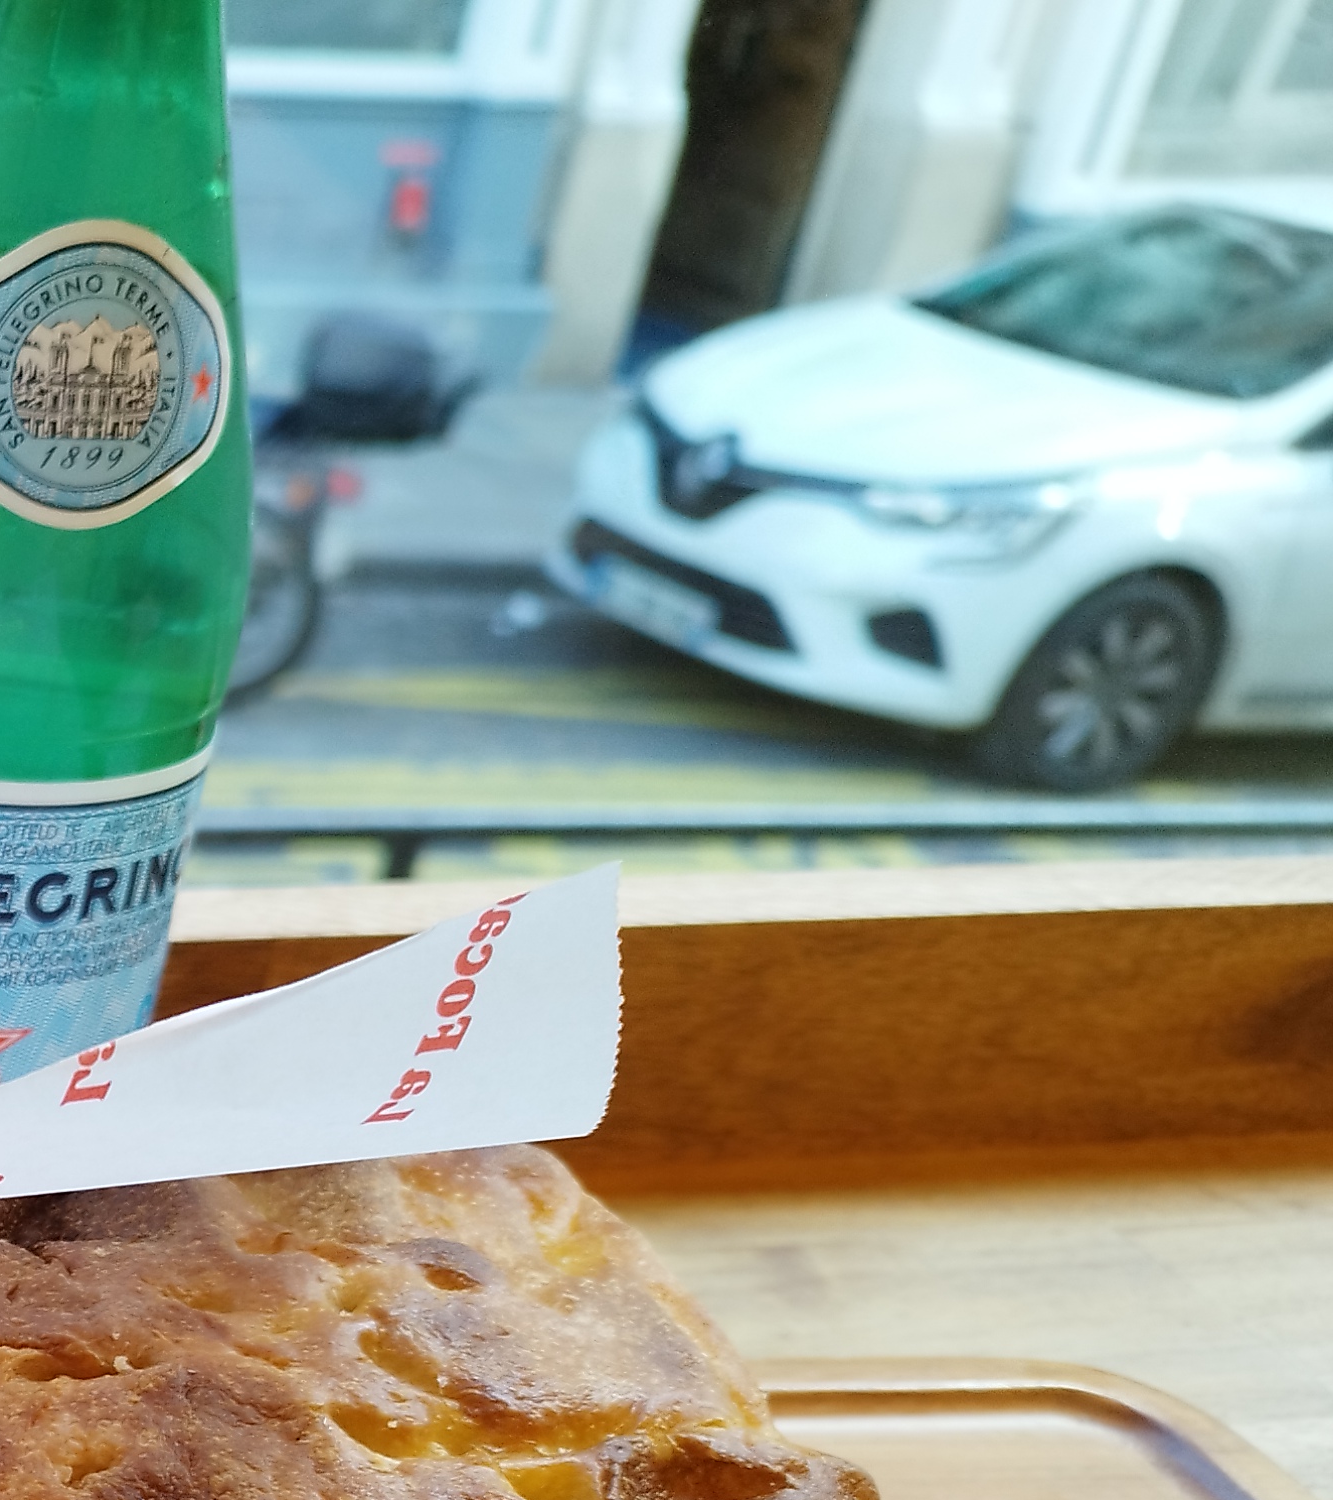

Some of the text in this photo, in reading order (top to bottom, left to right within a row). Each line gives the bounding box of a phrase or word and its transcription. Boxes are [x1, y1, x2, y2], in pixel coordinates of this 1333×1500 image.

[115, 276, 170, 337] TERME
[136, 376, 177, 449] ITALIA
[38, 446, 125, 470] 1899
